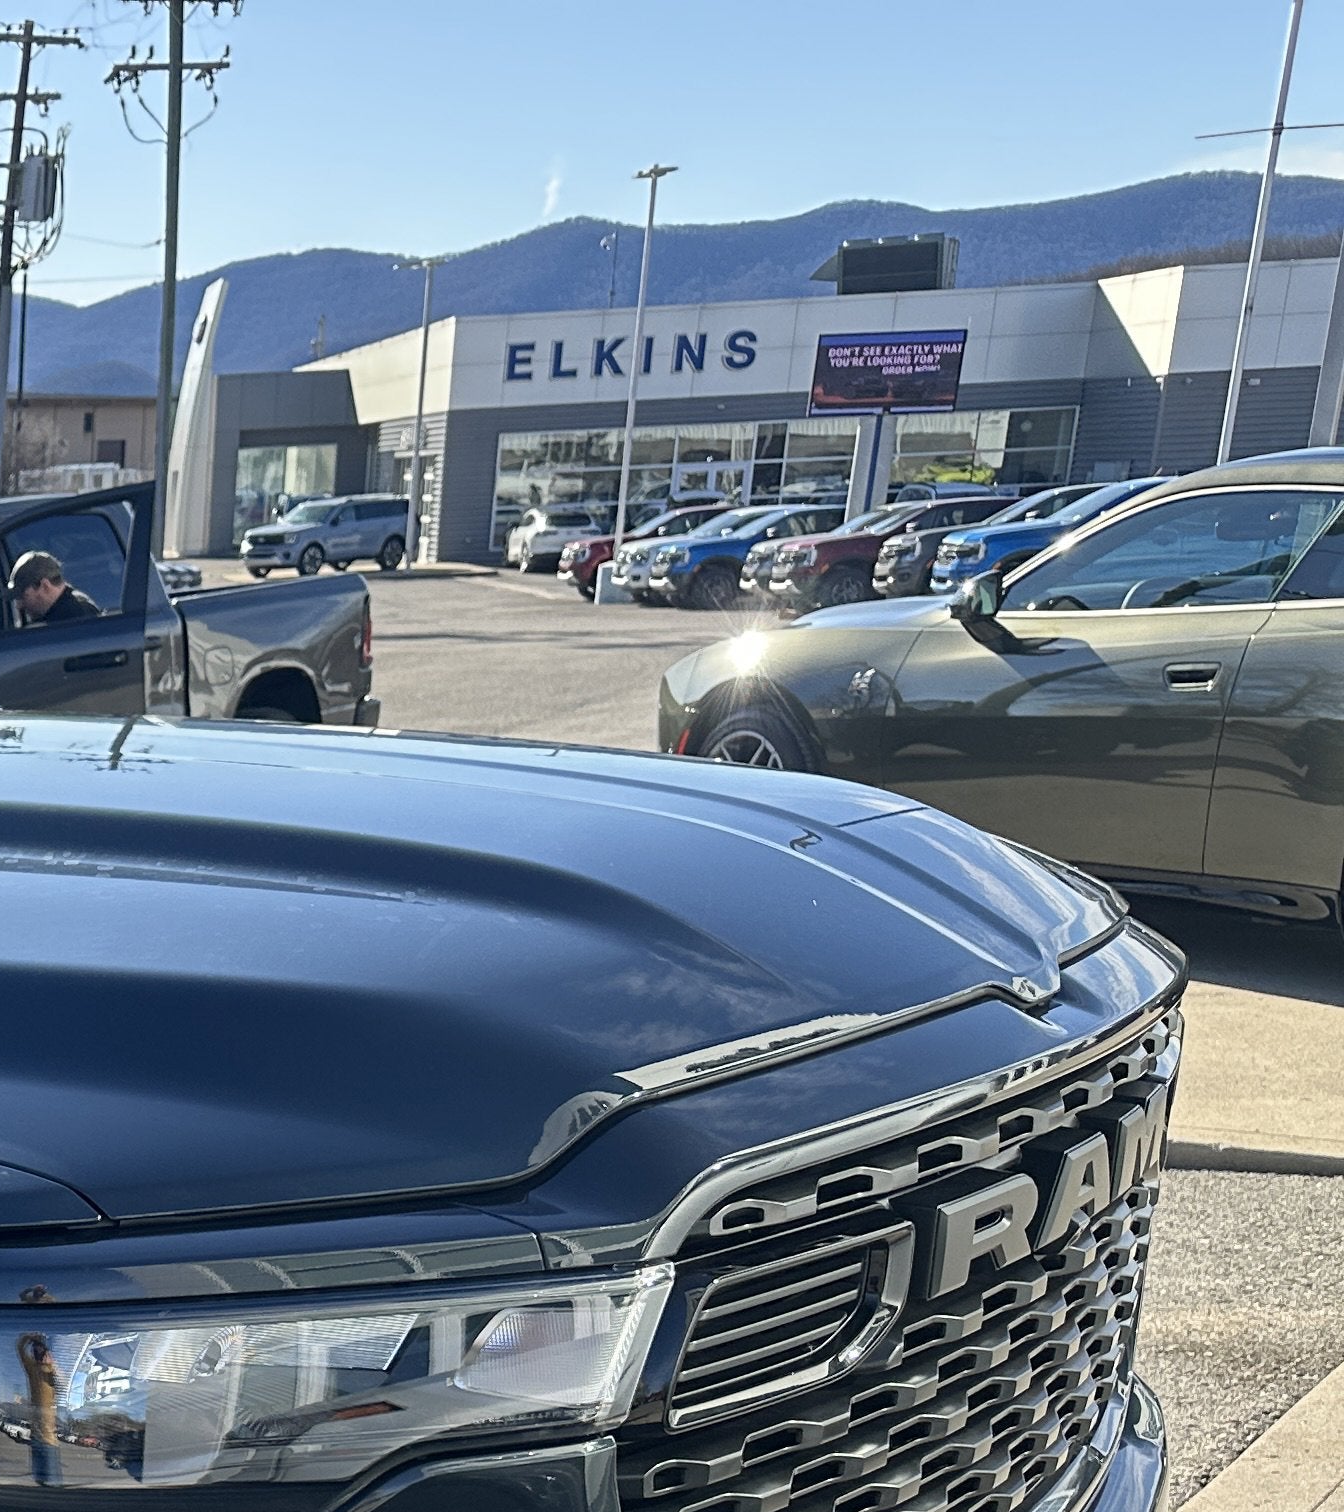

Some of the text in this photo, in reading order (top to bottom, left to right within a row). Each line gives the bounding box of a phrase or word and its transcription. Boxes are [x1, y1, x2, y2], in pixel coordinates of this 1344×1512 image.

[503, 329, 758, 383] ELKINS
[828, 342, 963, 358] DON'T SEE EXACTLY WHAT
[830, 353, 941, 368] YOU'RE LOOKING FOR?
[882, 365, 913, 375] ORDER
[920, 1082, 1168, 1301] RAM
